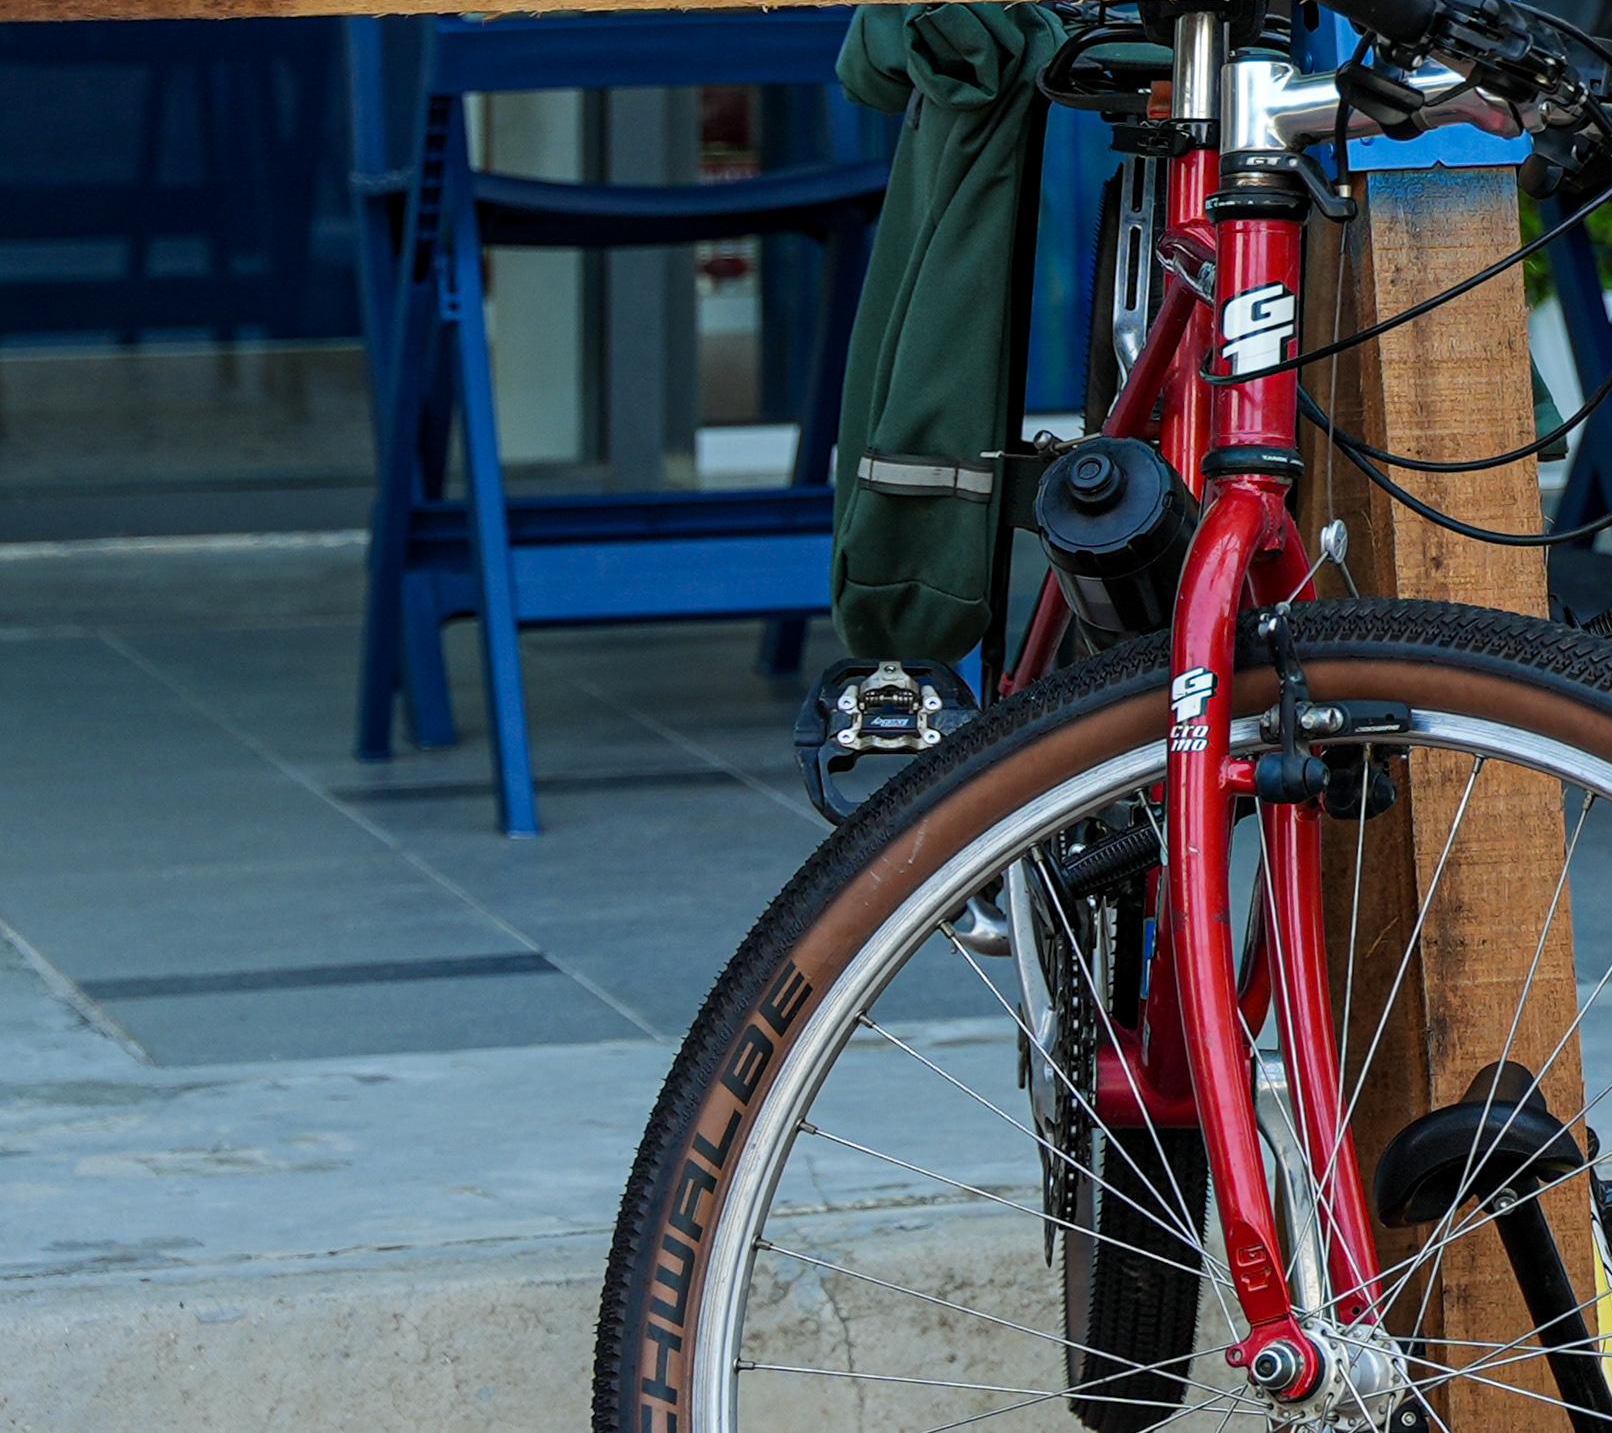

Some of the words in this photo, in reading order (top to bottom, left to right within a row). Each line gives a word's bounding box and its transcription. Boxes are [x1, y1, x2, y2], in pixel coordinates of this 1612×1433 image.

[1246, 156, 1281, 168] GT
[1223, 284, 1296, 375] GT
[1171, 667, 1214, 723] GT
